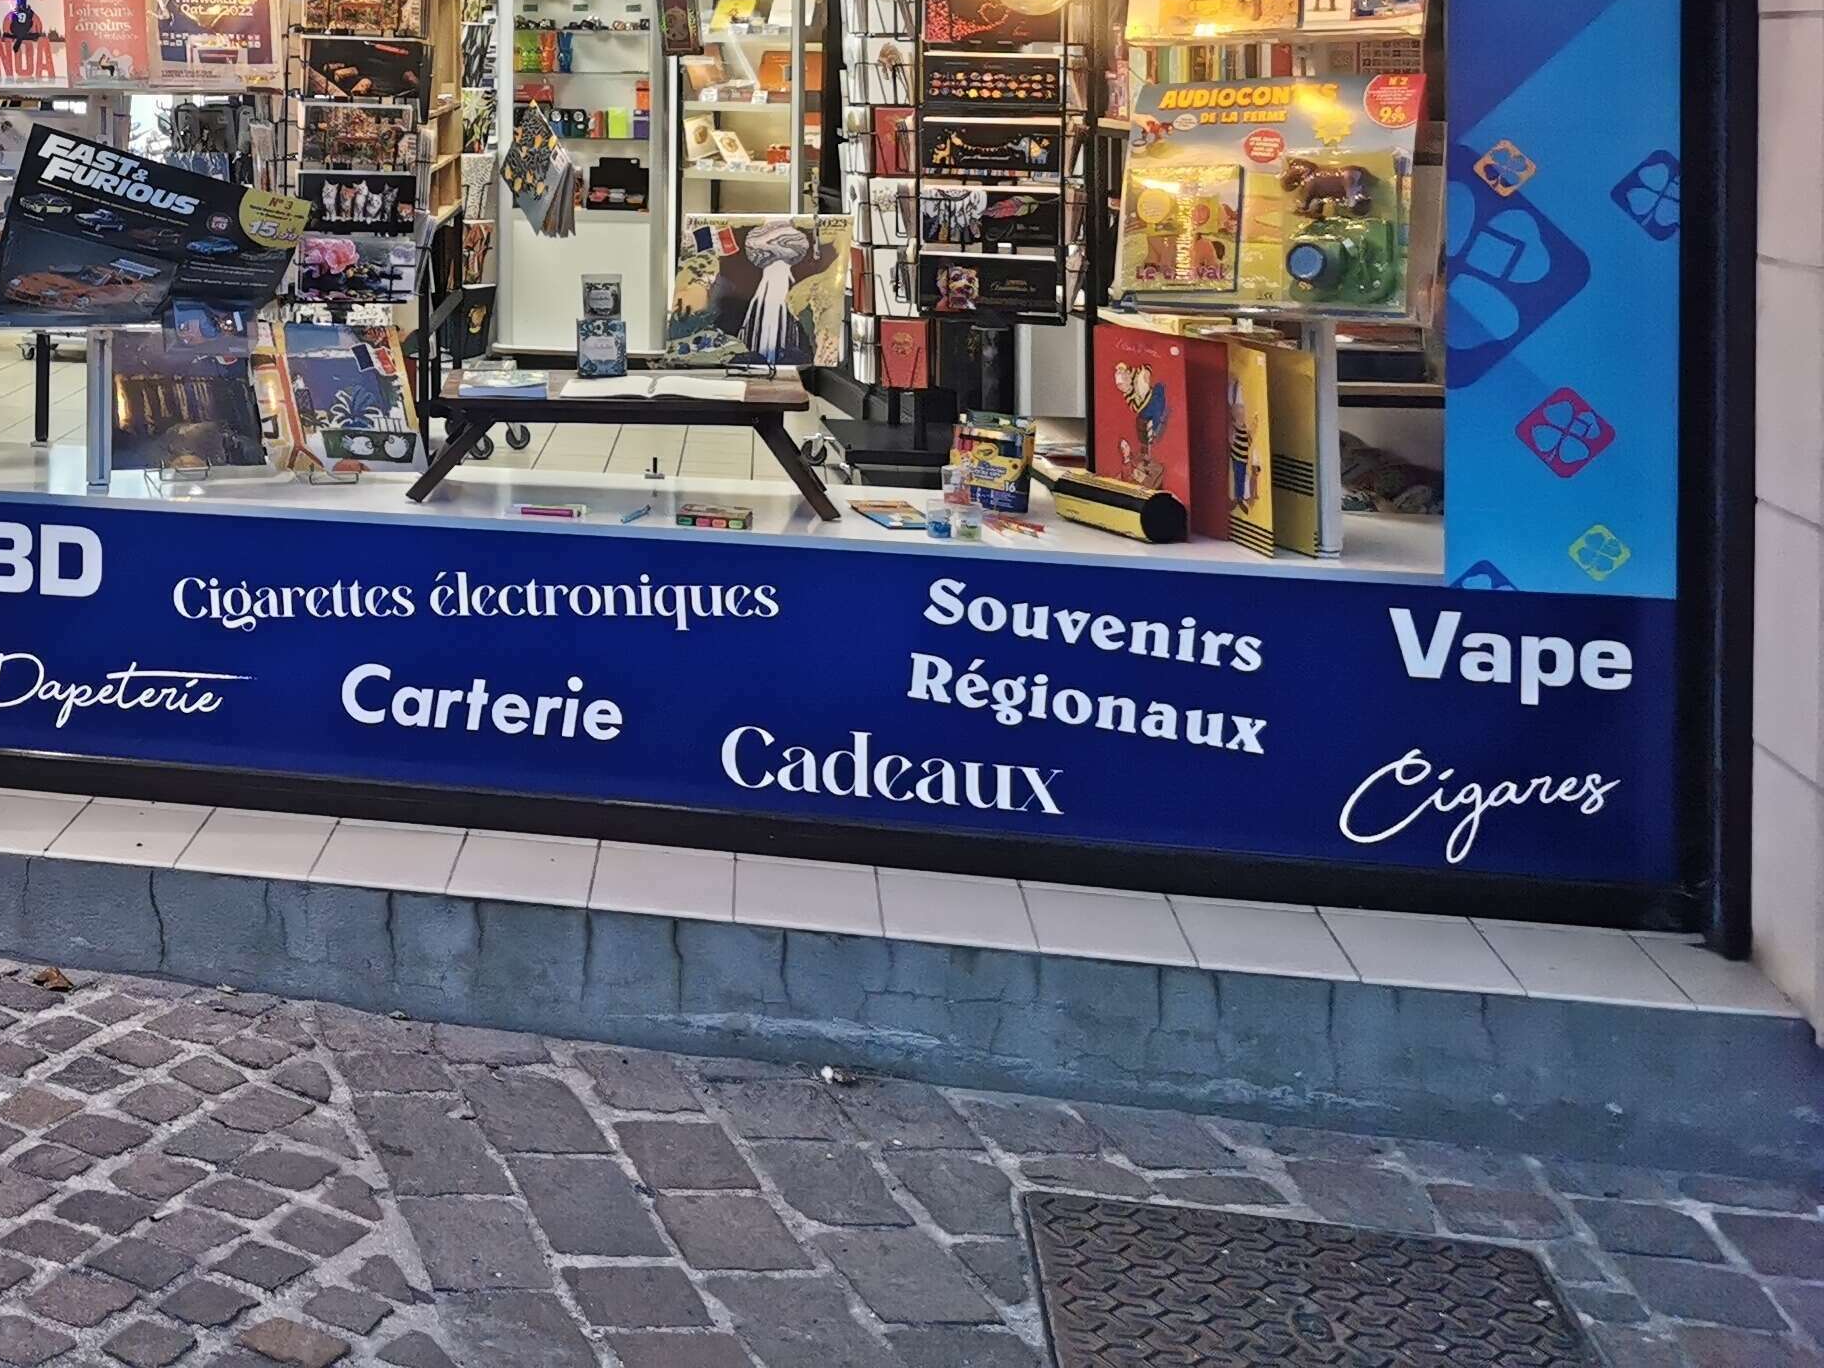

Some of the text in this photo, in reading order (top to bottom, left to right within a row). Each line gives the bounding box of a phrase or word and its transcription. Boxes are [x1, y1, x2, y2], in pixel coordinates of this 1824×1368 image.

[38, 133, 149, 183] FAST &
[40, 155, 200, 215] FURIOUS
[174, 572, 779, 631] Cigarettes électroniques
[924, 578, 1263, 672] Souvenirs
[1389, 608, 1632, 705] Vape
[342, 664, 622, 740] Carterie
[907, 653, 1266, 754] Régionaux
[722, 726, 1064, 815] Cadeaux
[1339, 749, 1620, 863] Cigares
